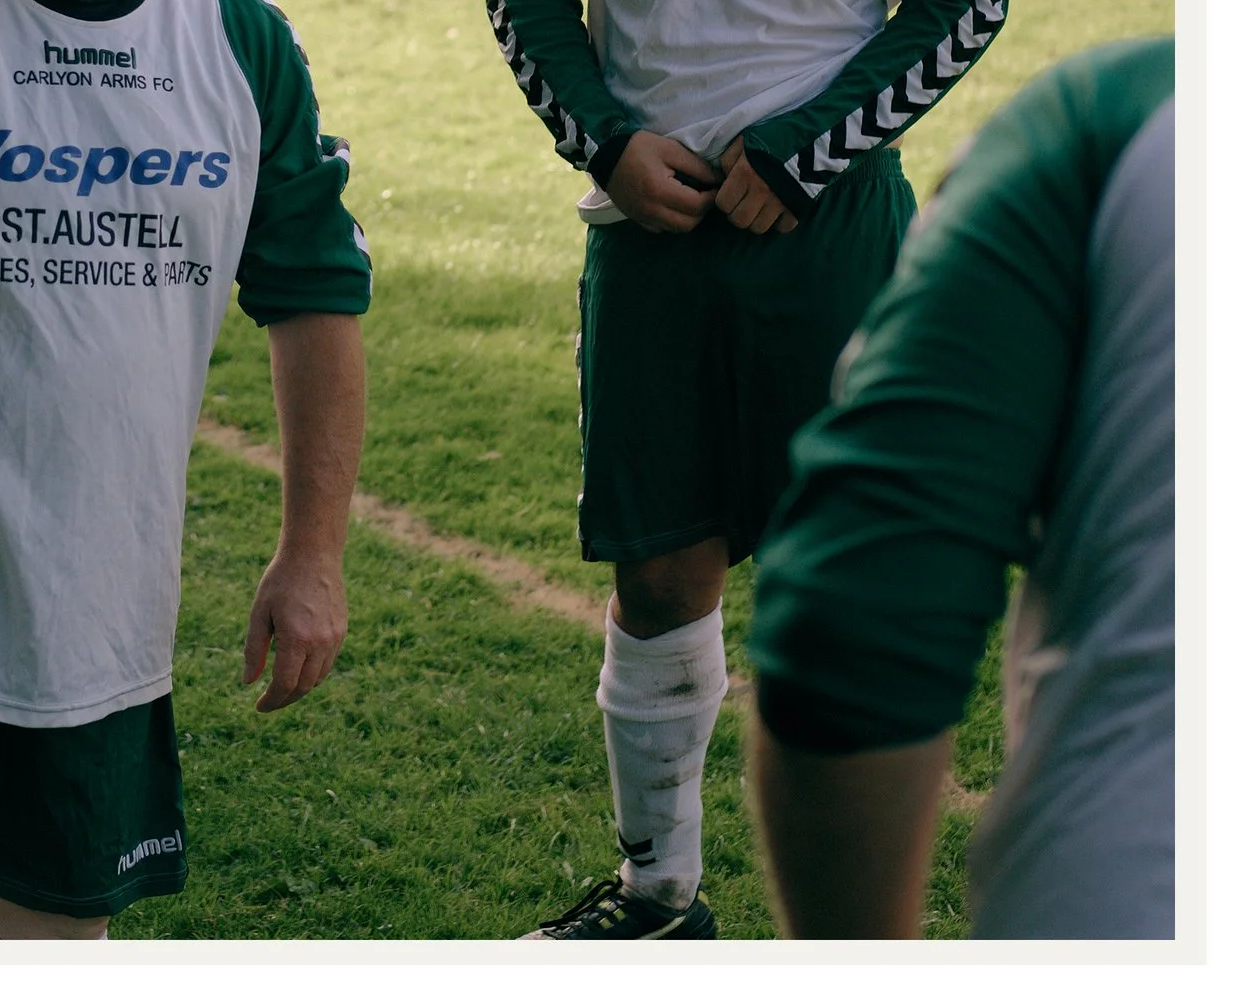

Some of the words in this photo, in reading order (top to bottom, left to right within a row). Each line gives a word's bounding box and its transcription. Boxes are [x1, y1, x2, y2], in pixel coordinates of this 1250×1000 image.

[43, 40, 136, 69] hummel
[13, 70, 91, 86] CARLYON
[100, 73, 147, 90] ARMS
[153, 78, 174, 92] FC
[1, 207, 183, 248] ST.AUSTELL
[43, 259, 135, 287] SERVICE
[142, 262, 157, 287] &
[164, 261, 212, 287] PARTS
[117, 829, 183, 875] hummel
